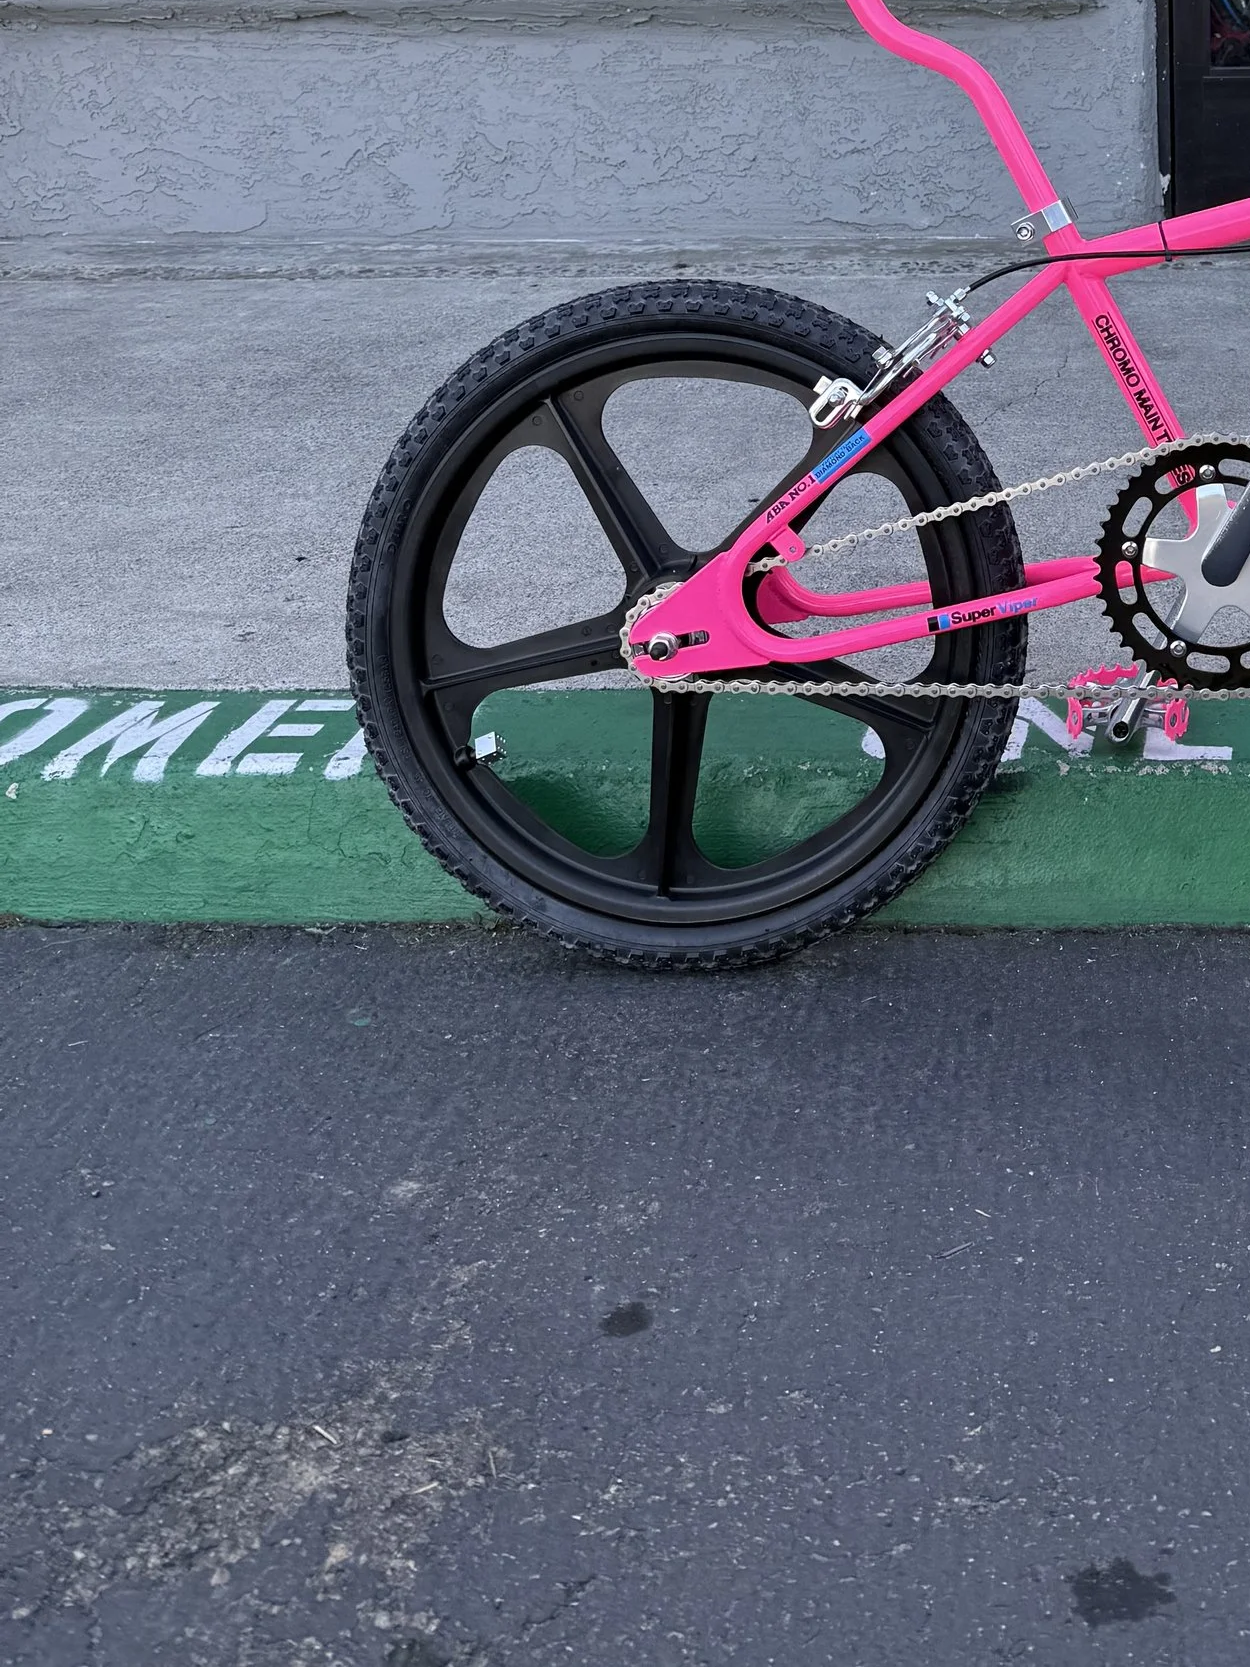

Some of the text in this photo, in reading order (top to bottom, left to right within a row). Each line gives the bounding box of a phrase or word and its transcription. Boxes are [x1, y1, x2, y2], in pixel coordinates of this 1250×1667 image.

[1094, 314, 1142, 389] CHROMO
[1133, 387, 1164, 433] MAIN
[765, 496, 791, 524] ABA
[951, 597, 1039, 625] Super Viper
